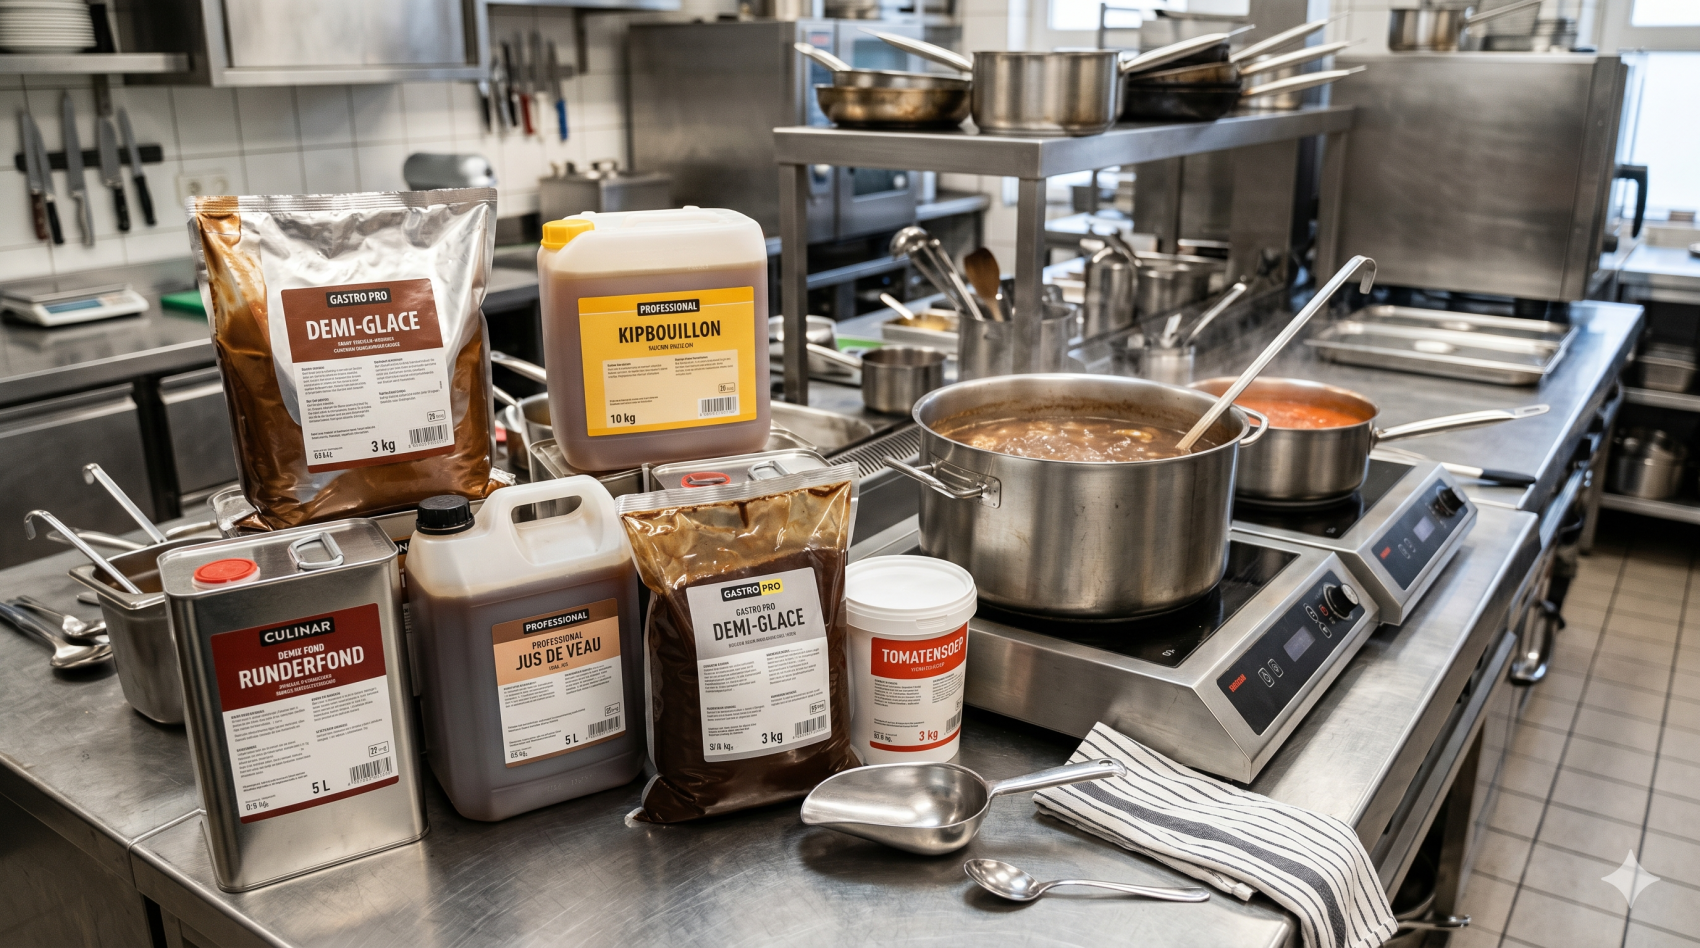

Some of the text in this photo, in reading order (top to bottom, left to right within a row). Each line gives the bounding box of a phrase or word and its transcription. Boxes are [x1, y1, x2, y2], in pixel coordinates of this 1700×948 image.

[329, 290, 388, 305] GASTRO PRO
[640, 301, 698, 314] PROFESSIONAL
[305, 310, 421, 340] DEMI-GLACE
[618, 319, 721, 344] KIPBOUILLON
[610, 413, 636, 425] 10 kg
[371, 440, 379, 453] 3
[381, 439, 396, 453] kg
[736, 602, 776, 617] GASTRO PRO
[525, 611, 588, 632] PROFESSIONAL
[713, 608, 805, 641] DEMI-GLACE
[264, 621, 331, 643] CULINAR
[532, 631, 583, 650] PROFESSIONAL
[303, 643, 325, 656] FOND
[515, 651, 542, 671] JUS
[546, 646, 564, 664] DE
[566, 636, 601, 658] VEAU
[881, 636, 964, 664] TOMATENSOEP
[238, 645, 365, 690] RUNDERFOND
[565, 734, 571, 745] 5
[572, 733, 579, 743] L
[761, 732, 768, 744] 3
[770, 731, 783, 744] kg
[919, 729, 938, 741] 3 kg
[312, 781, 320, 794] 5
[322, 780, 331, 792] L
